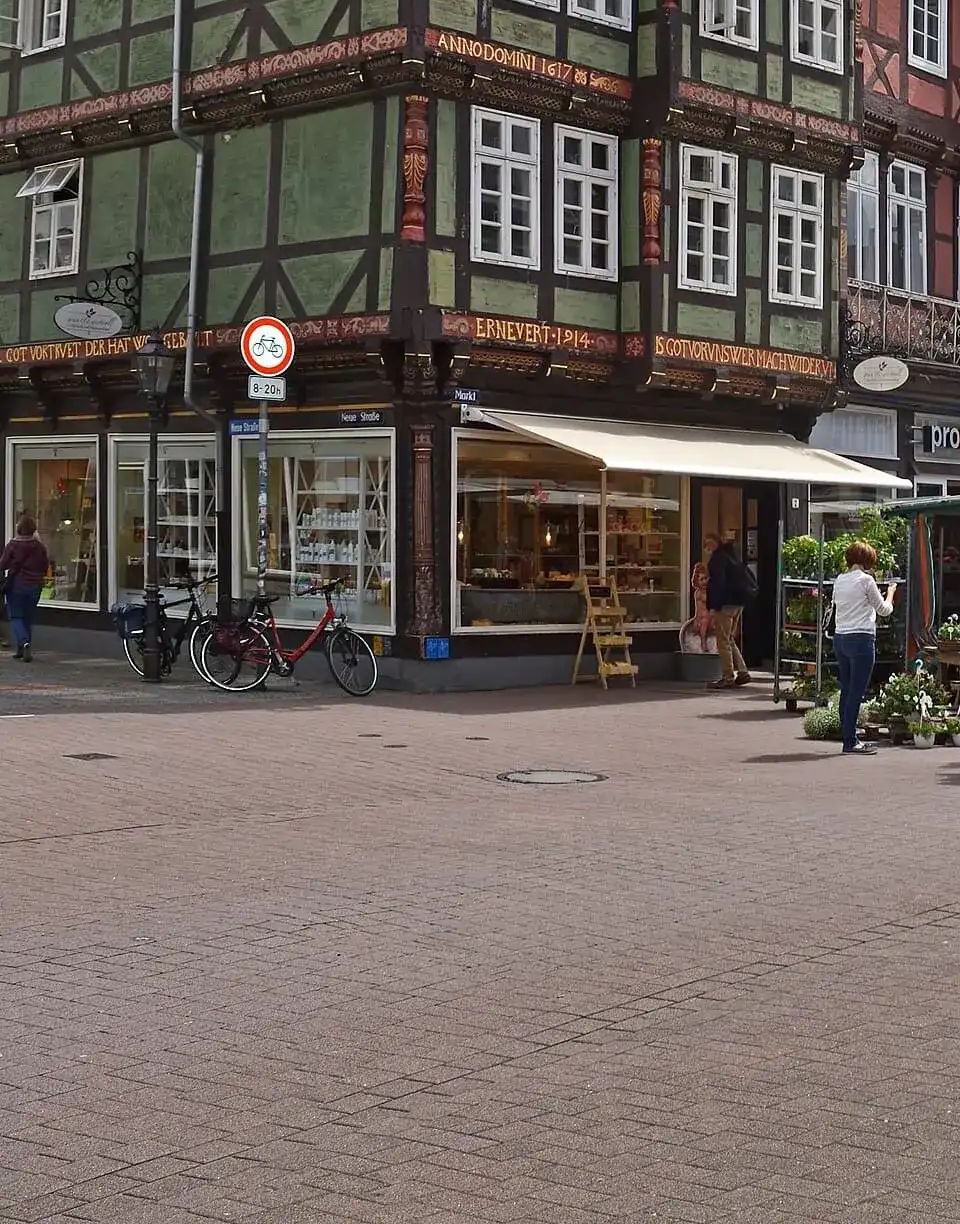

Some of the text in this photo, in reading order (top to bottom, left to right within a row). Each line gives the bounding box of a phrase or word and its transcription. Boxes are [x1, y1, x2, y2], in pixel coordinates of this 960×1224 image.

[541, 58, 574, 80] 1617
[454, 389, 476, 401] Markt
[341, 410, 380, 422] Neue Straße
